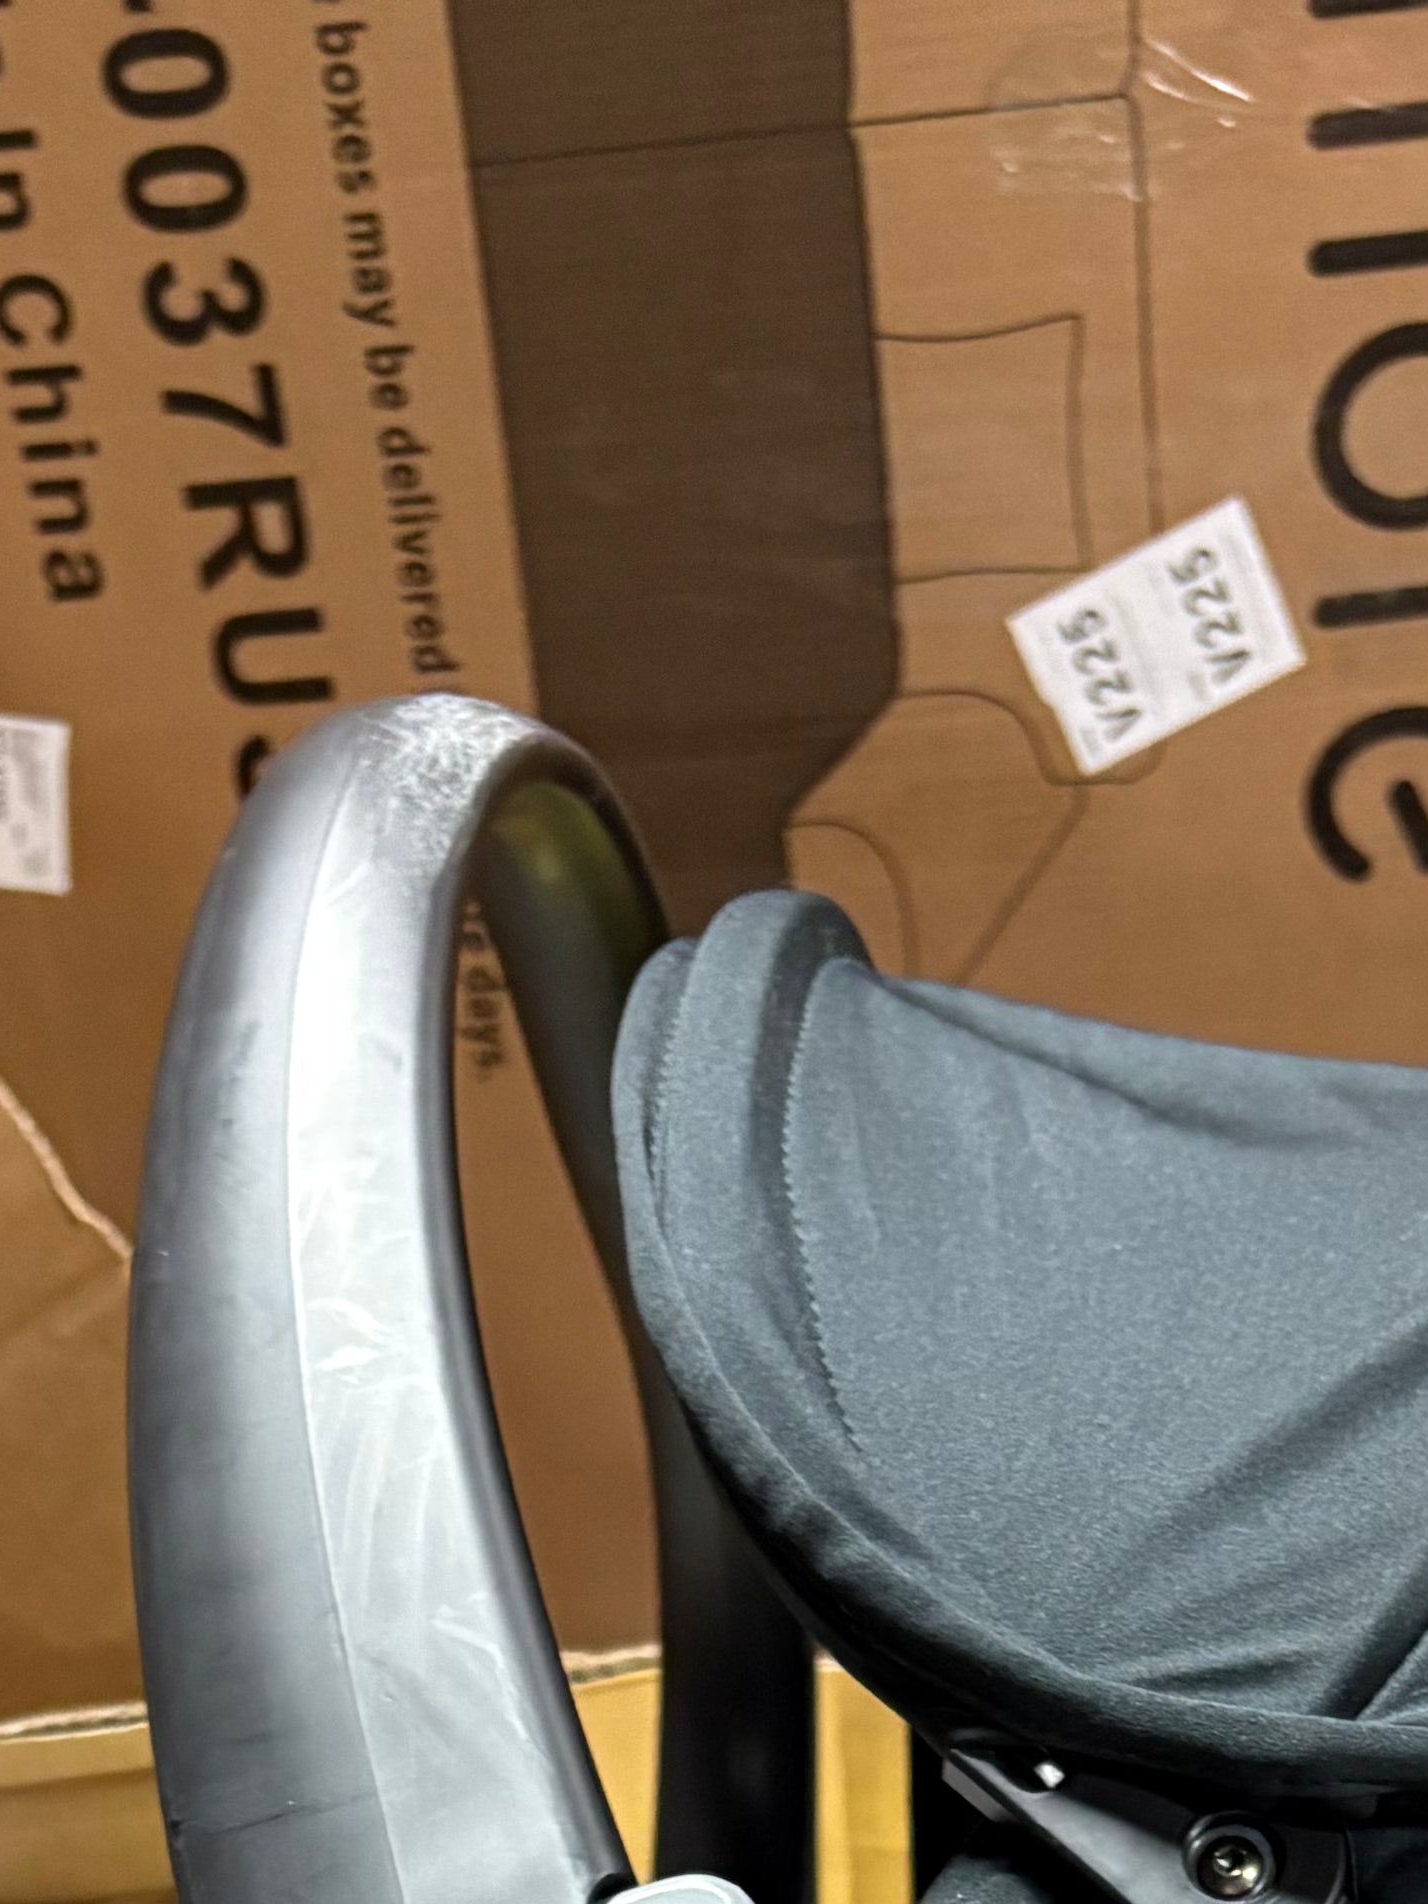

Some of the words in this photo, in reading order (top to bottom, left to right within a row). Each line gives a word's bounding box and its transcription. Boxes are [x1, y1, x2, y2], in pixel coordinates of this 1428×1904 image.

[314, 20, 376, 197] boxes
[341, 210, 399, 329] may
[362, 343, 416, 413] be
[379, 427, 460, 677] delivered
[1169, 546, 1251, 685] V225
[1056, 608, 1142, 742] V225
